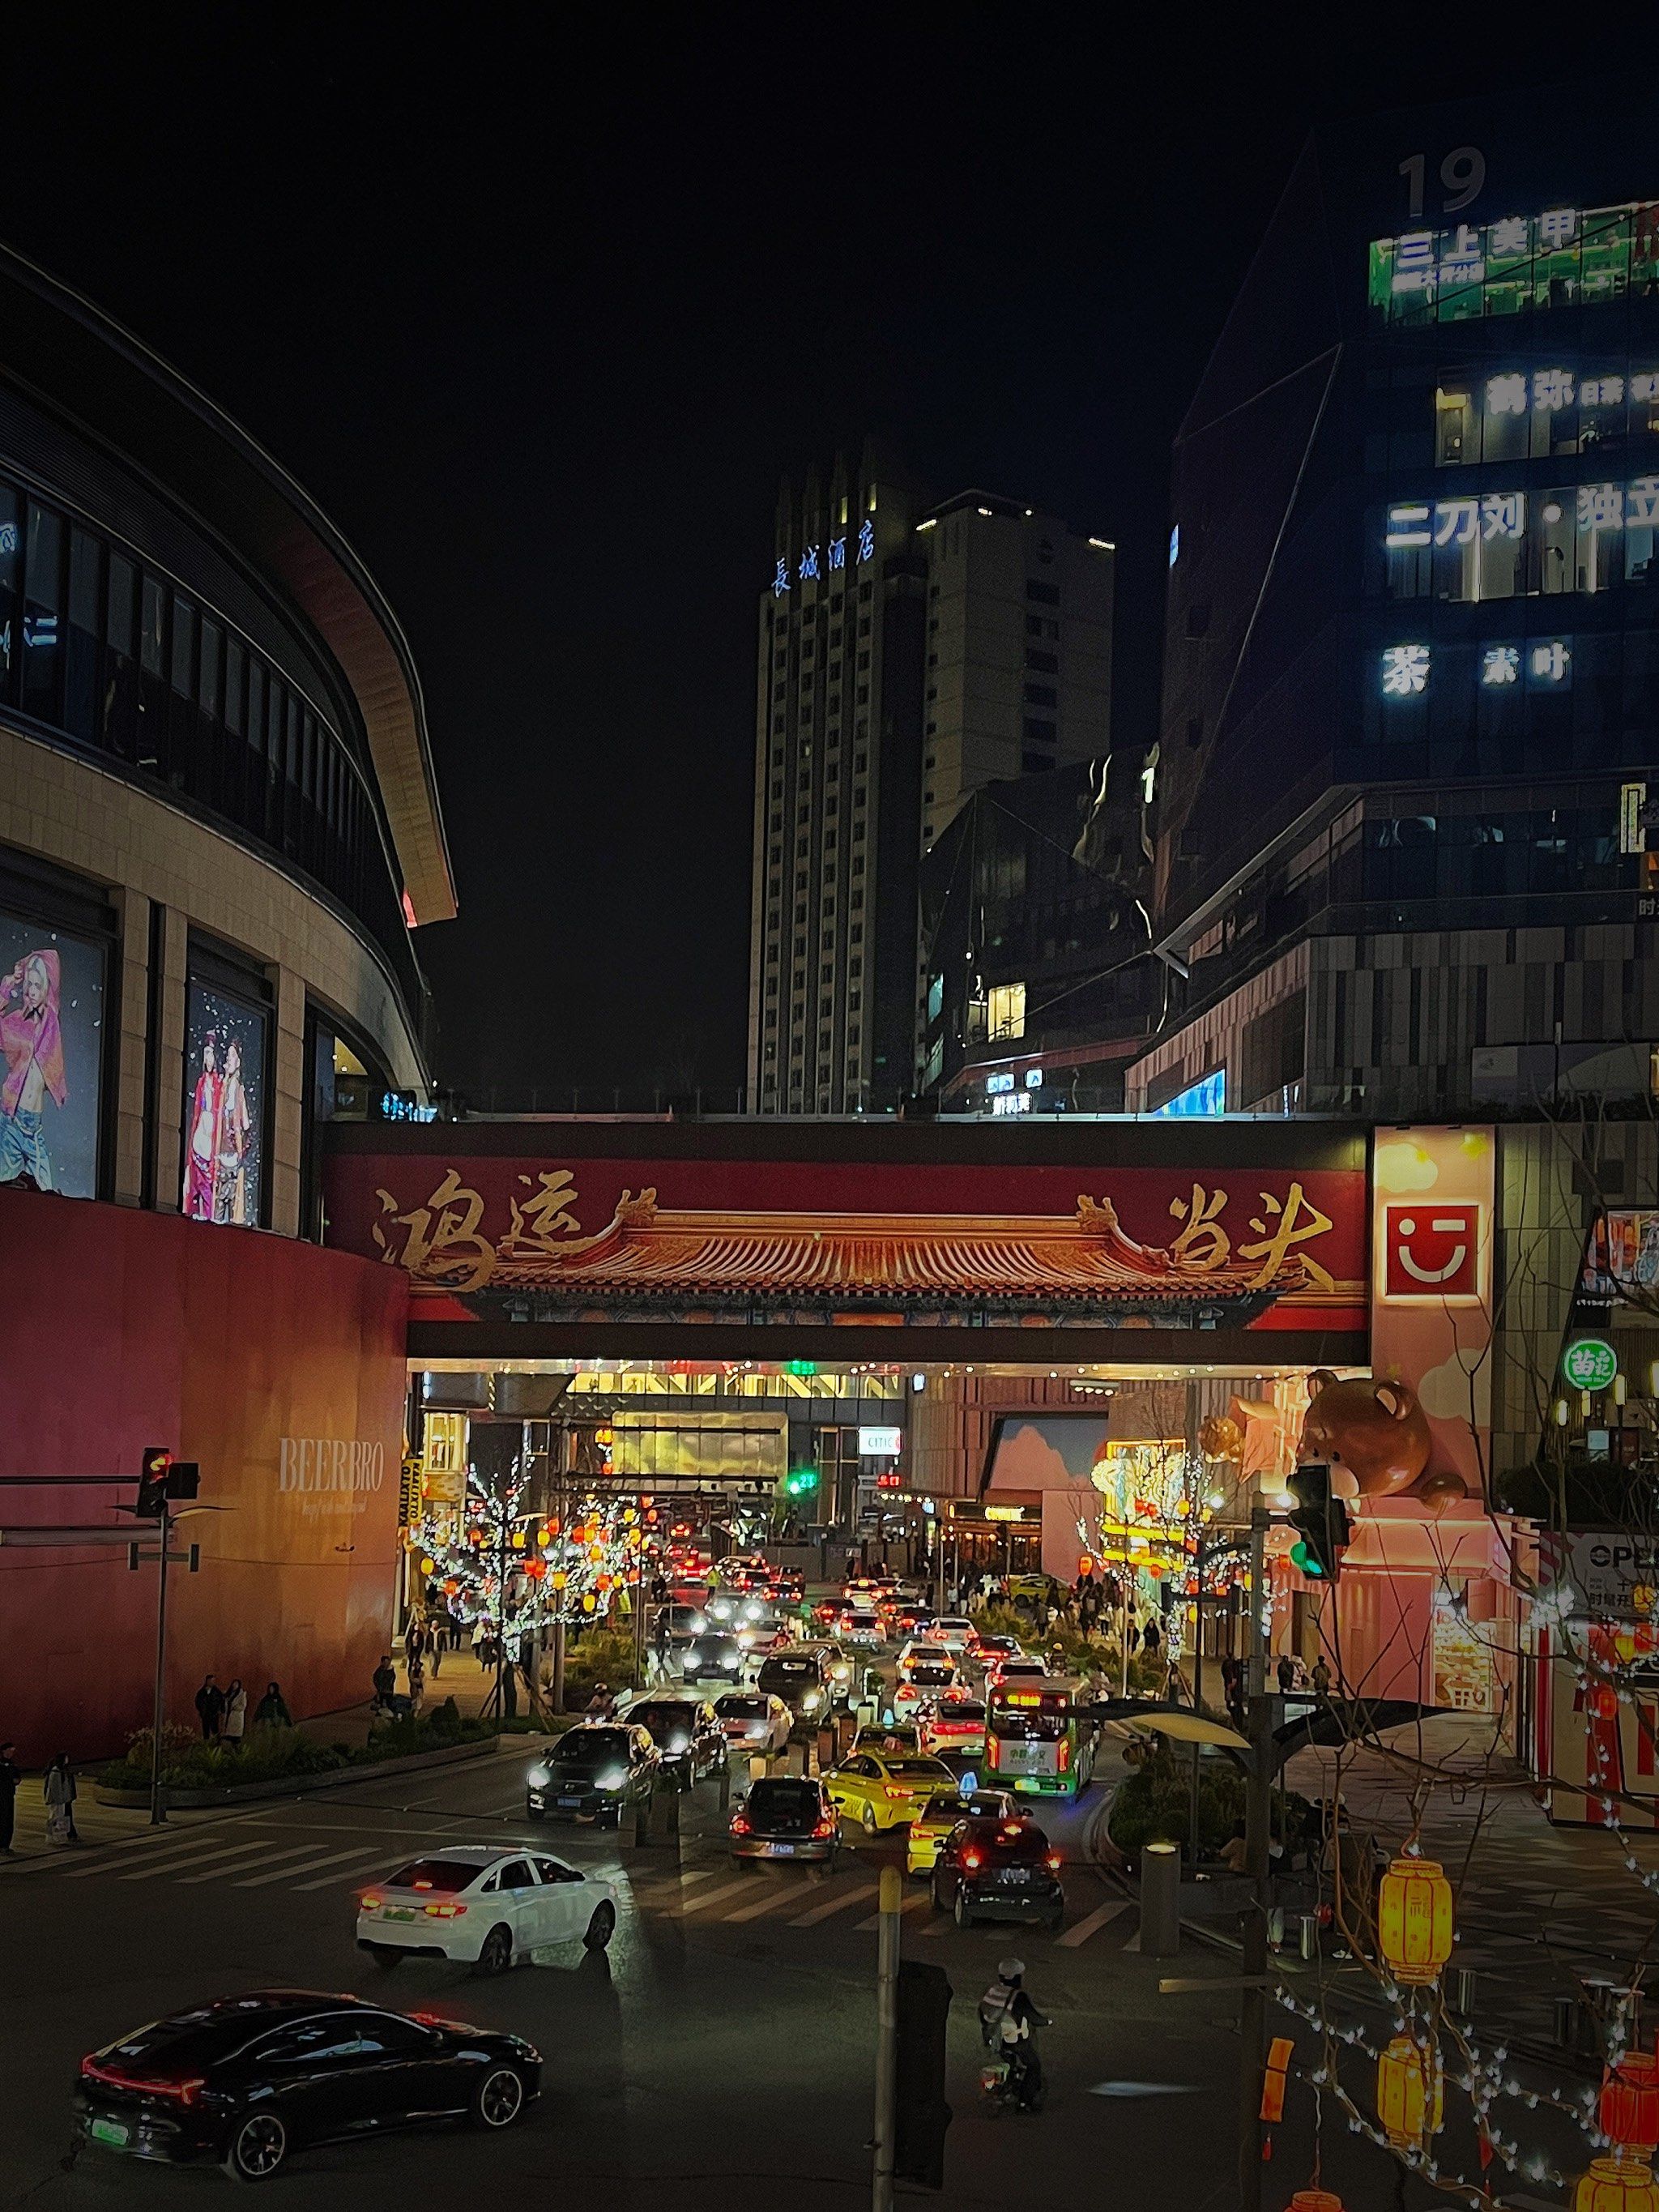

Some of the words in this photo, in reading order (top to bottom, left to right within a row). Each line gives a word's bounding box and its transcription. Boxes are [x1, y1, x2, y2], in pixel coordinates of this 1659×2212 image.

[1398, 147, 1486, 218] 19
[1397, 208, 1576, 267] 三上美甲
[1383, 646, 1430, 695] 茶
[278, 1437, 385, 1492] BEERBRO
[868, 1437, 893, 1448] CITIC
[1590, 1544, 1659, 1569] OPE
